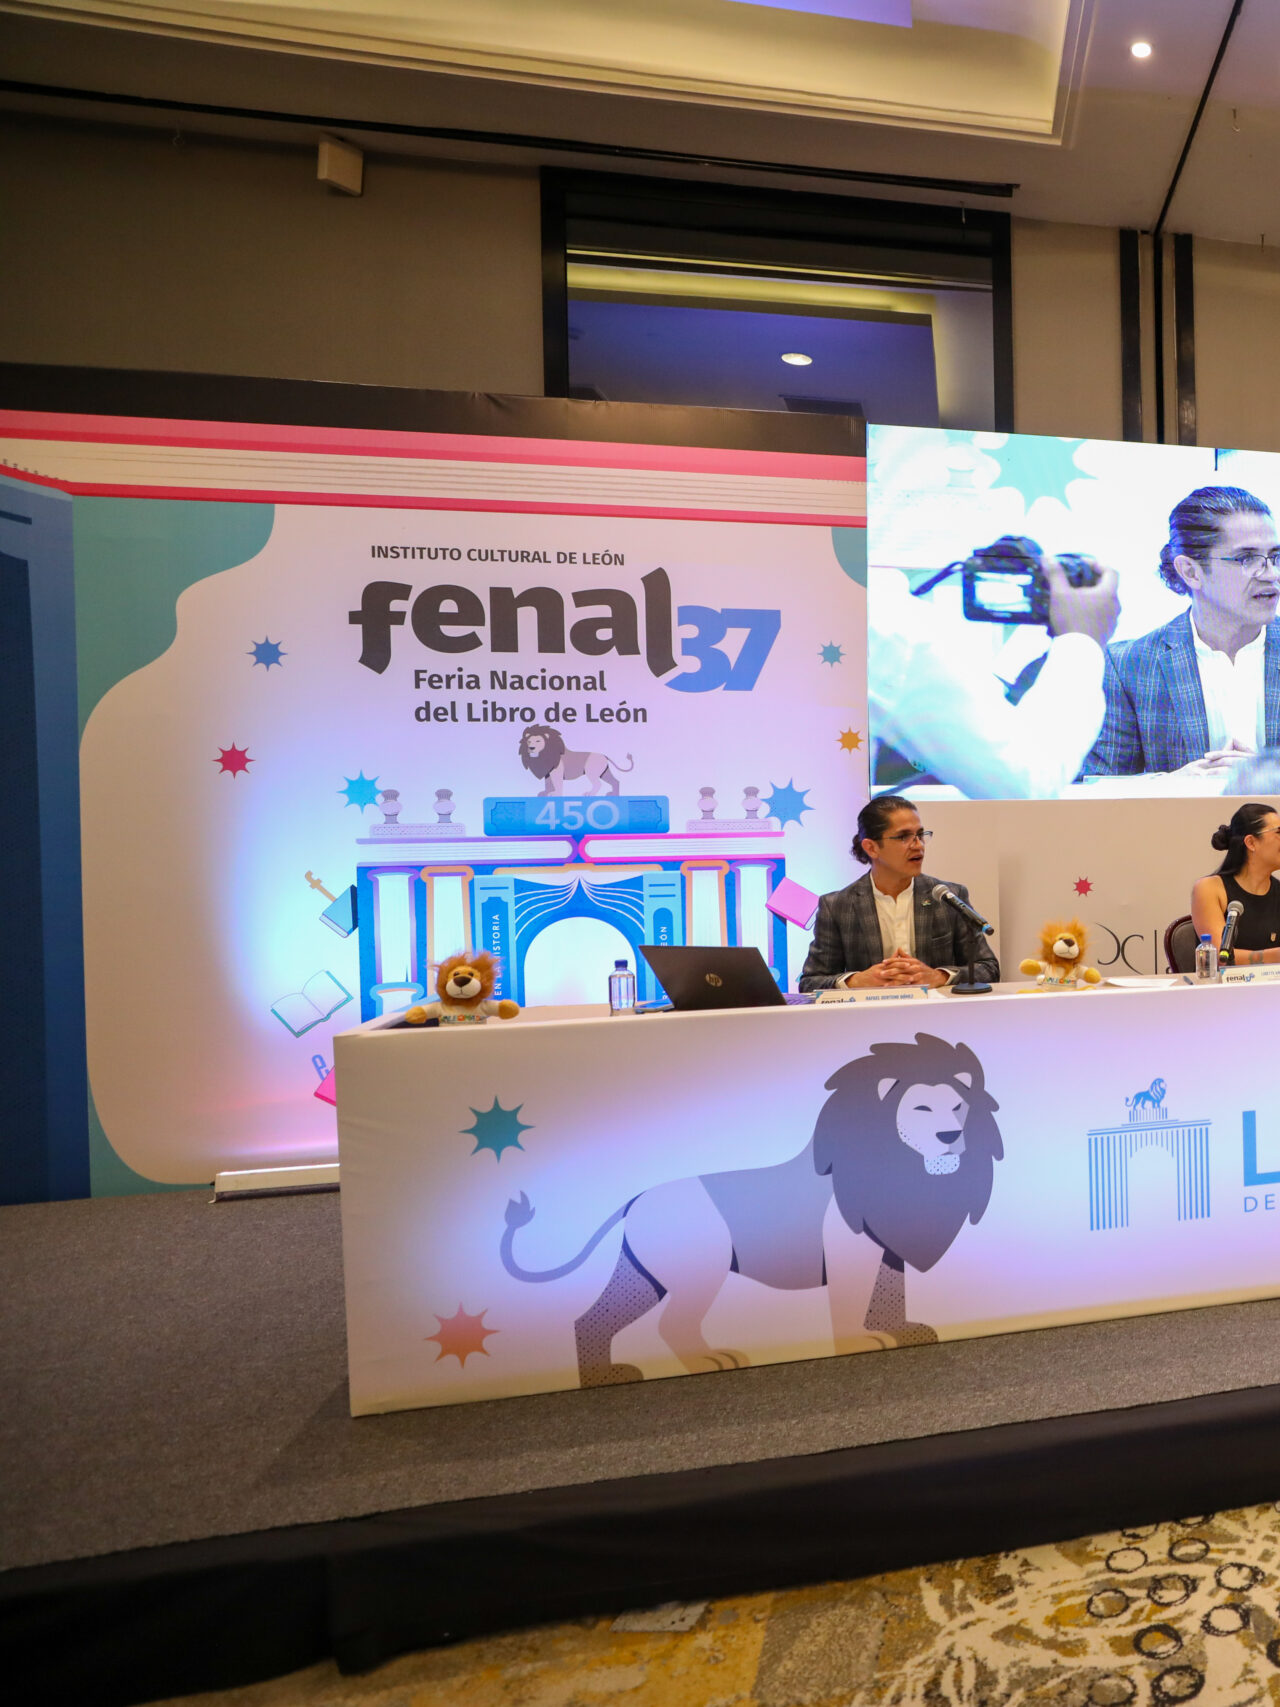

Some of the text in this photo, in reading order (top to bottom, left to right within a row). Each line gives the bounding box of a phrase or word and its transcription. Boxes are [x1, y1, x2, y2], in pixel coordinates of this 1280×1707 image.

[371, 545, 625, 566] INSTITUTO CULTURAL DE LEÓN
[348, 566, 781, 693] fenal 37
[414, 667, 607, 691] Feria Nacional
[414, 699, 647, 723] del Libro de León
[535, 800, 620, 831] 450
